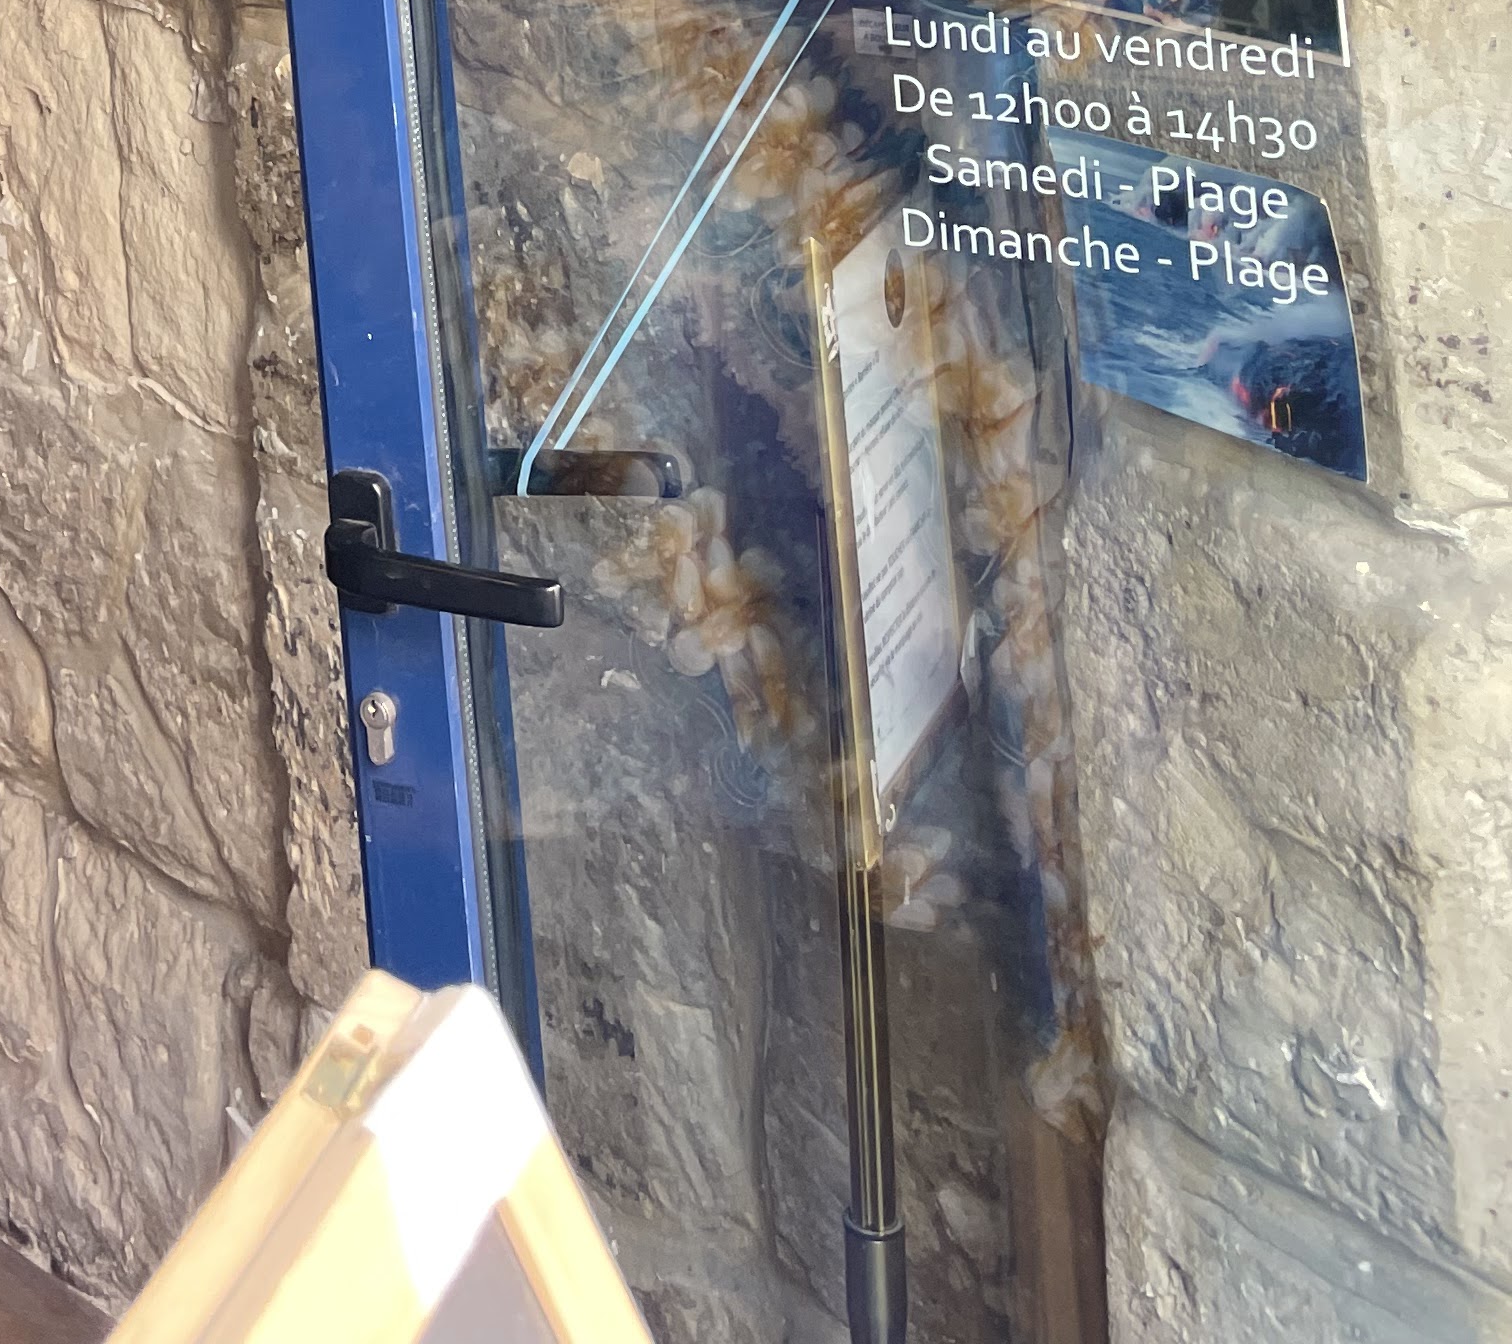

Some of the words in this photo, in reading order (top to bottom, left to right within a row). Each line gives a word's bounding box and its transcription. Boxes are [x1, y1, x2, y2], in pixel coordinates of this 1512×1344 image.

[885, 5, 1011, 55] Lundi
[1026, 27, 1081, 61] au
[1095, 27, 1315, 79] vendredi
[893, 73, 954, 117] De
[968, 81, 1112, 132] 12h00
[1126, 90, 1152, 136] à
[1166, 99, 1318, 160] 14h30
[926, 143, 1104, 201] Samedi
[1150, 164, 1289, 230] Plage
[901, 207, 1141, 274] Dimanche
[1188, 240, 1331, 306] Plage
